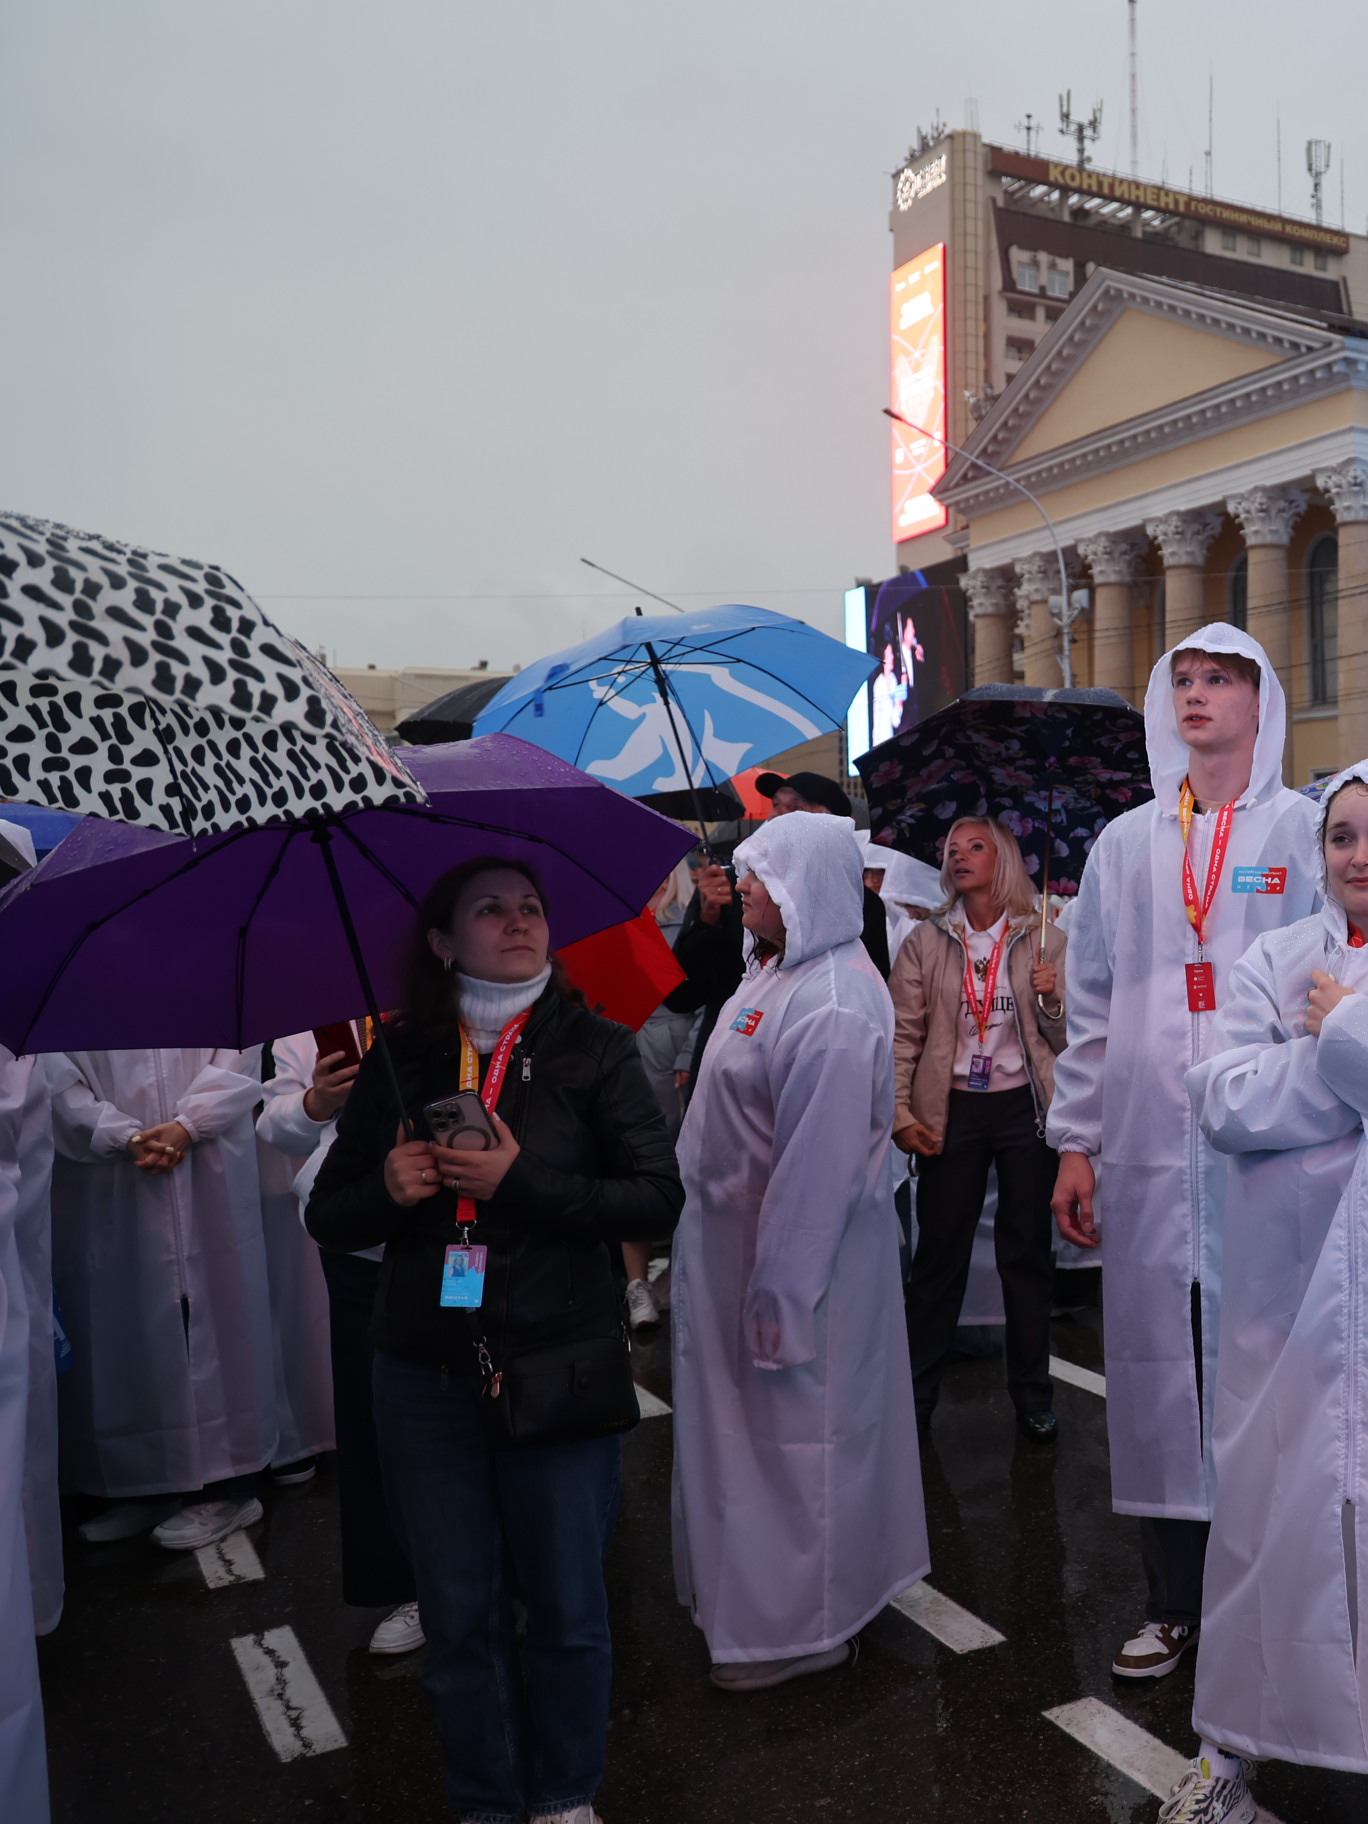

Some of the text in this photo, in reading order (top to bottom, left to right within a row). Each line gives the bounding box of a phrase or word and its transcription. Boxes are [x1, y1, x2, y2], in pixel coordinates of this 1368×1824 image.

[1049, 162, 1348, 247] КОНТИНЕНТ ГОСТИНИЧНЫЙ КОМПЛЕКС
[1219, 811, 1229, 837] ВЕСНА
[1211, 848, 1221, 873] ОДНА
[1186, 877, 1194, 900] ОДНА
[1205, 875, 1216, 908] СТРАНА
[1237, 875, 1281, 884] ВЕСНА
[465, 1065, 474, 1089] ДНА
[490, 1054, 505, 1085] ОДНА
